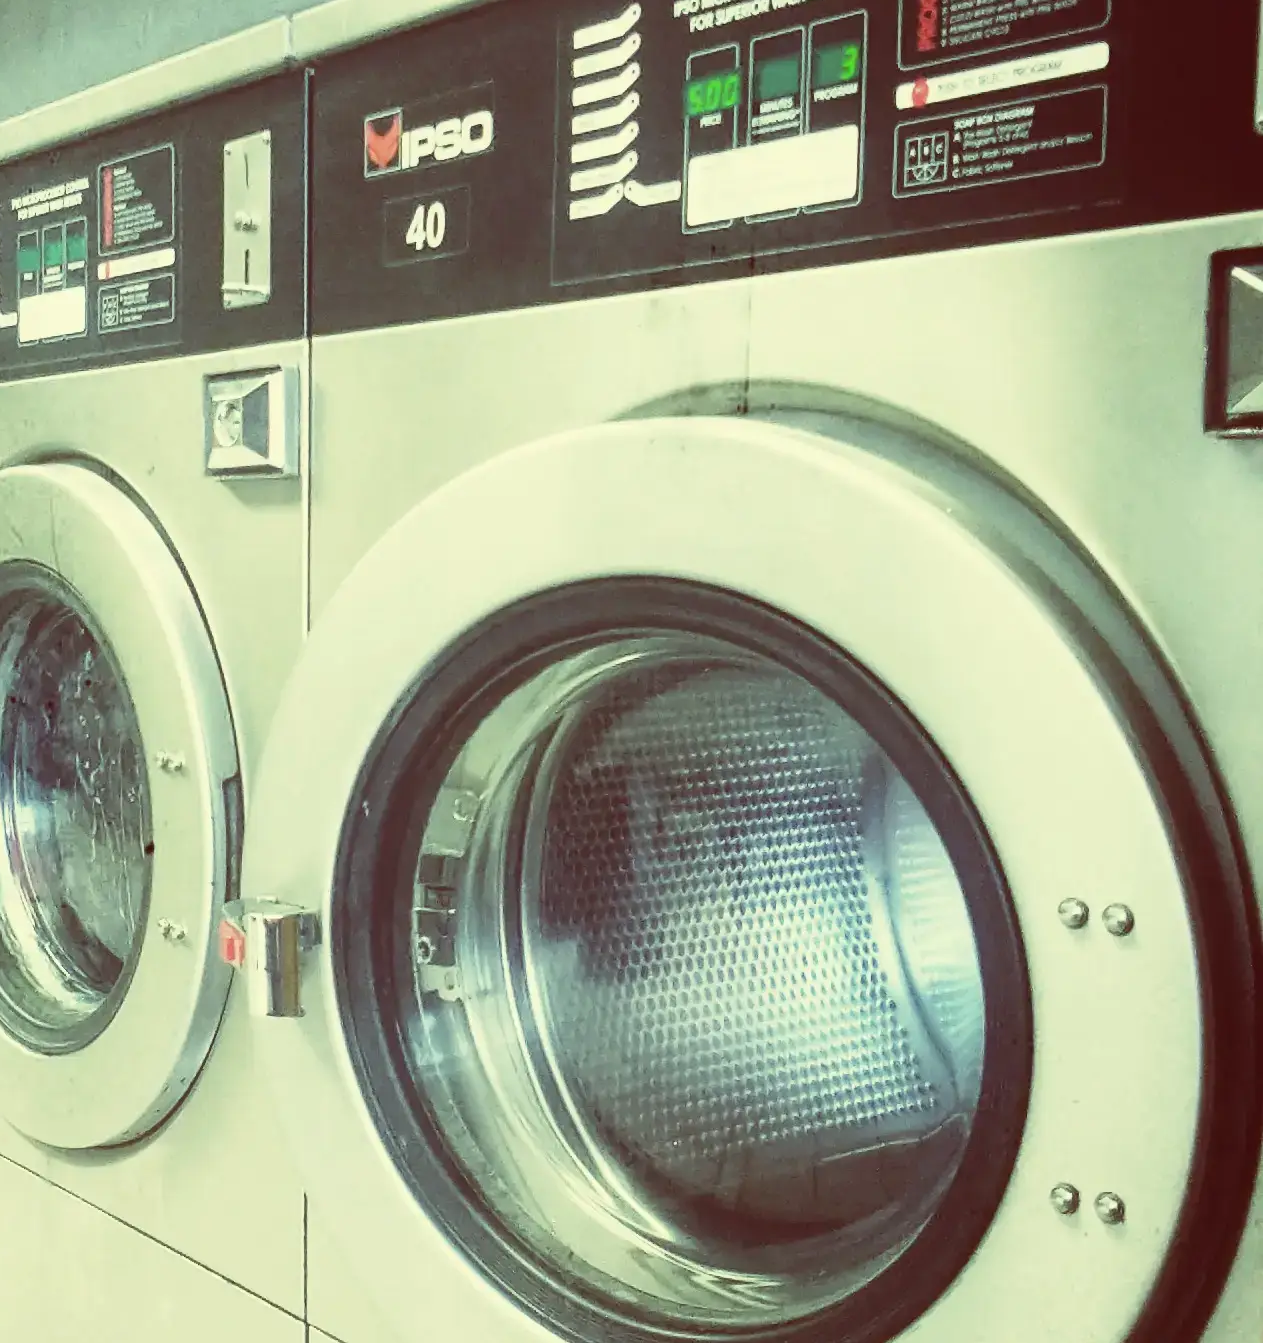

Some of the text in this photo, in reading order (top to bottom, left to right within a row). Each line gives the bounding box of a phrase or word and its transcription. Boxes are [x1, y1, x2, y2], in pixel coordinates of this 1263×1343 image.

[690, 13, 714, 32] FOR
[840, 45, 858, 80] 3
[401, 110, 494, 170] IPSO
[406, 201, 445, 250] 40
